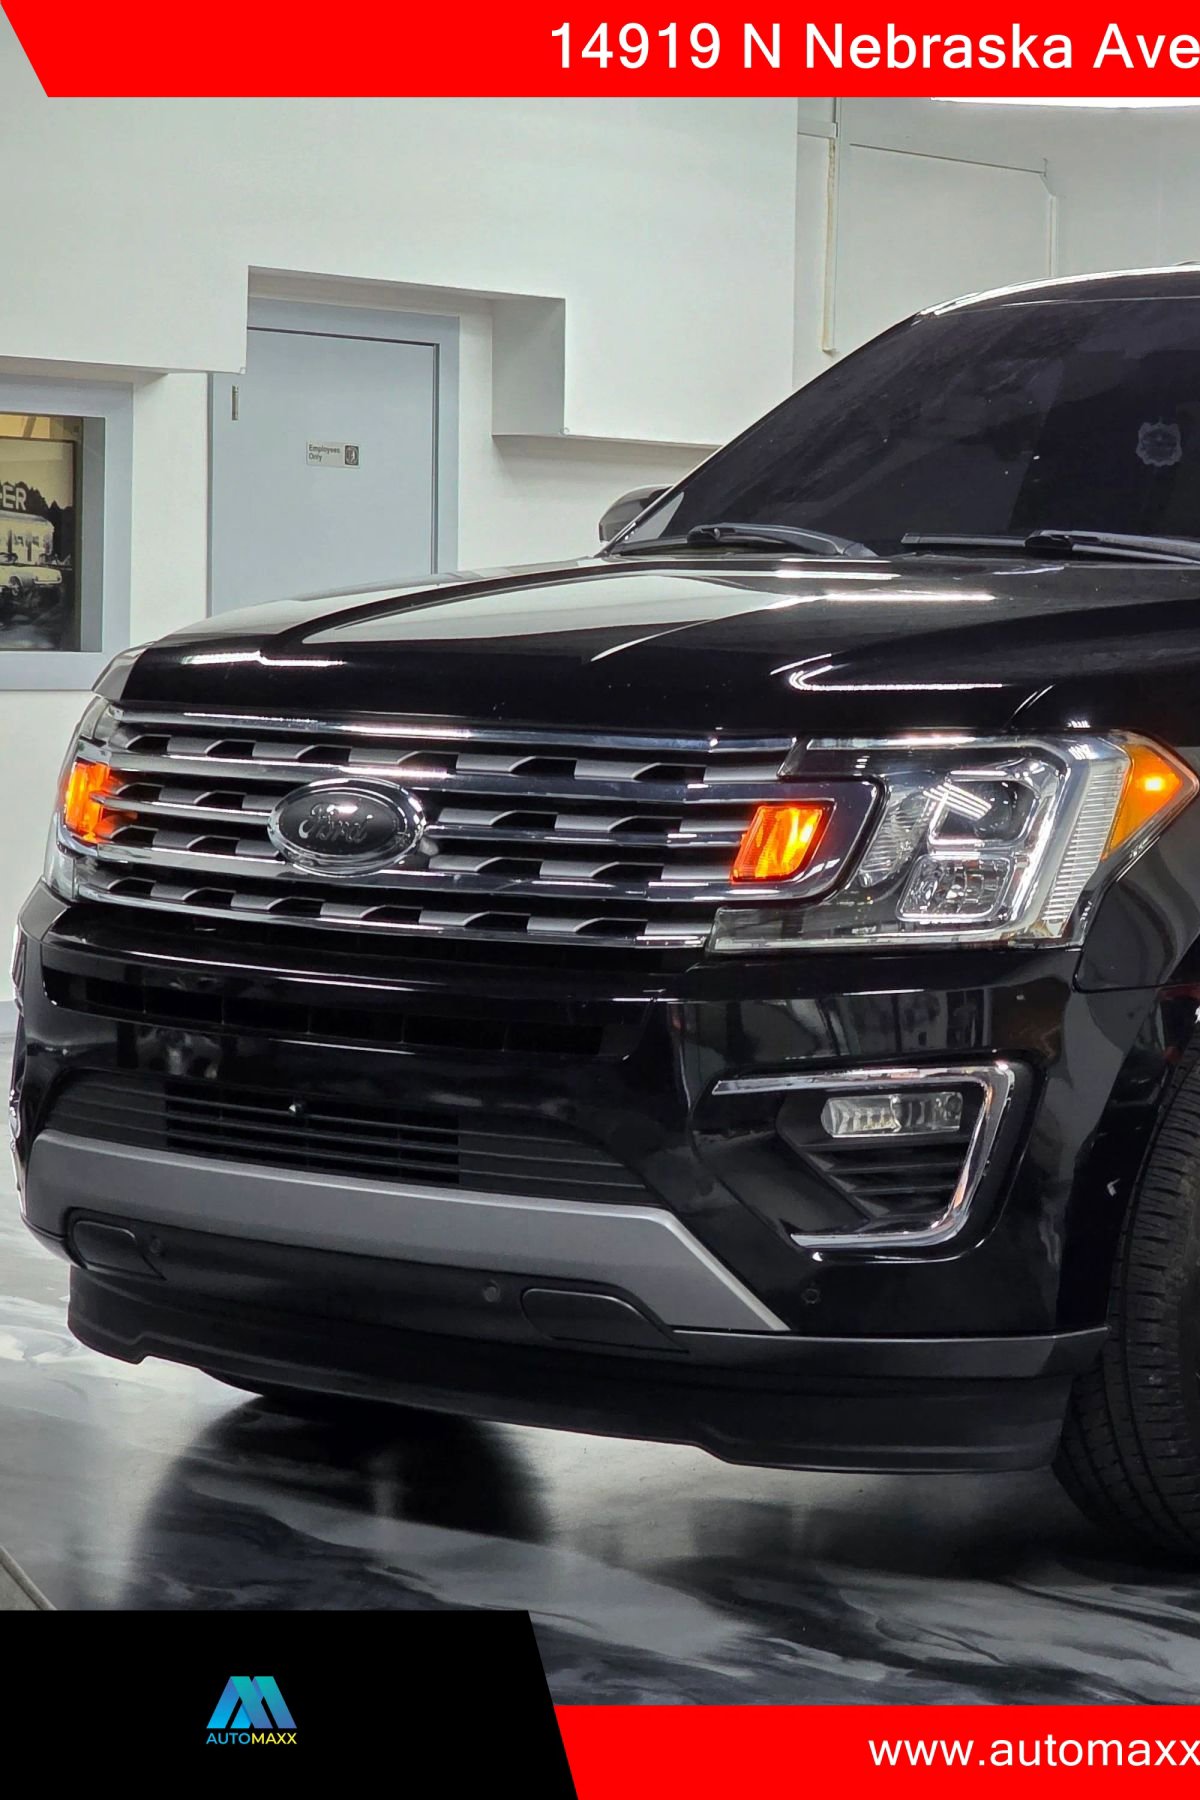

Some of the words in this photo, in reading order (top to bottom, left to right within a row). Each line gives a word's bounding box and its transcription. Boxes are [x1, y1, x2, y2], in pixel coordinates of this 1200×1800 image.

[308, 444, 341, 455] Employees
[308, 453, 322, 462] Only
[297, 803, 374, 843] Ford
